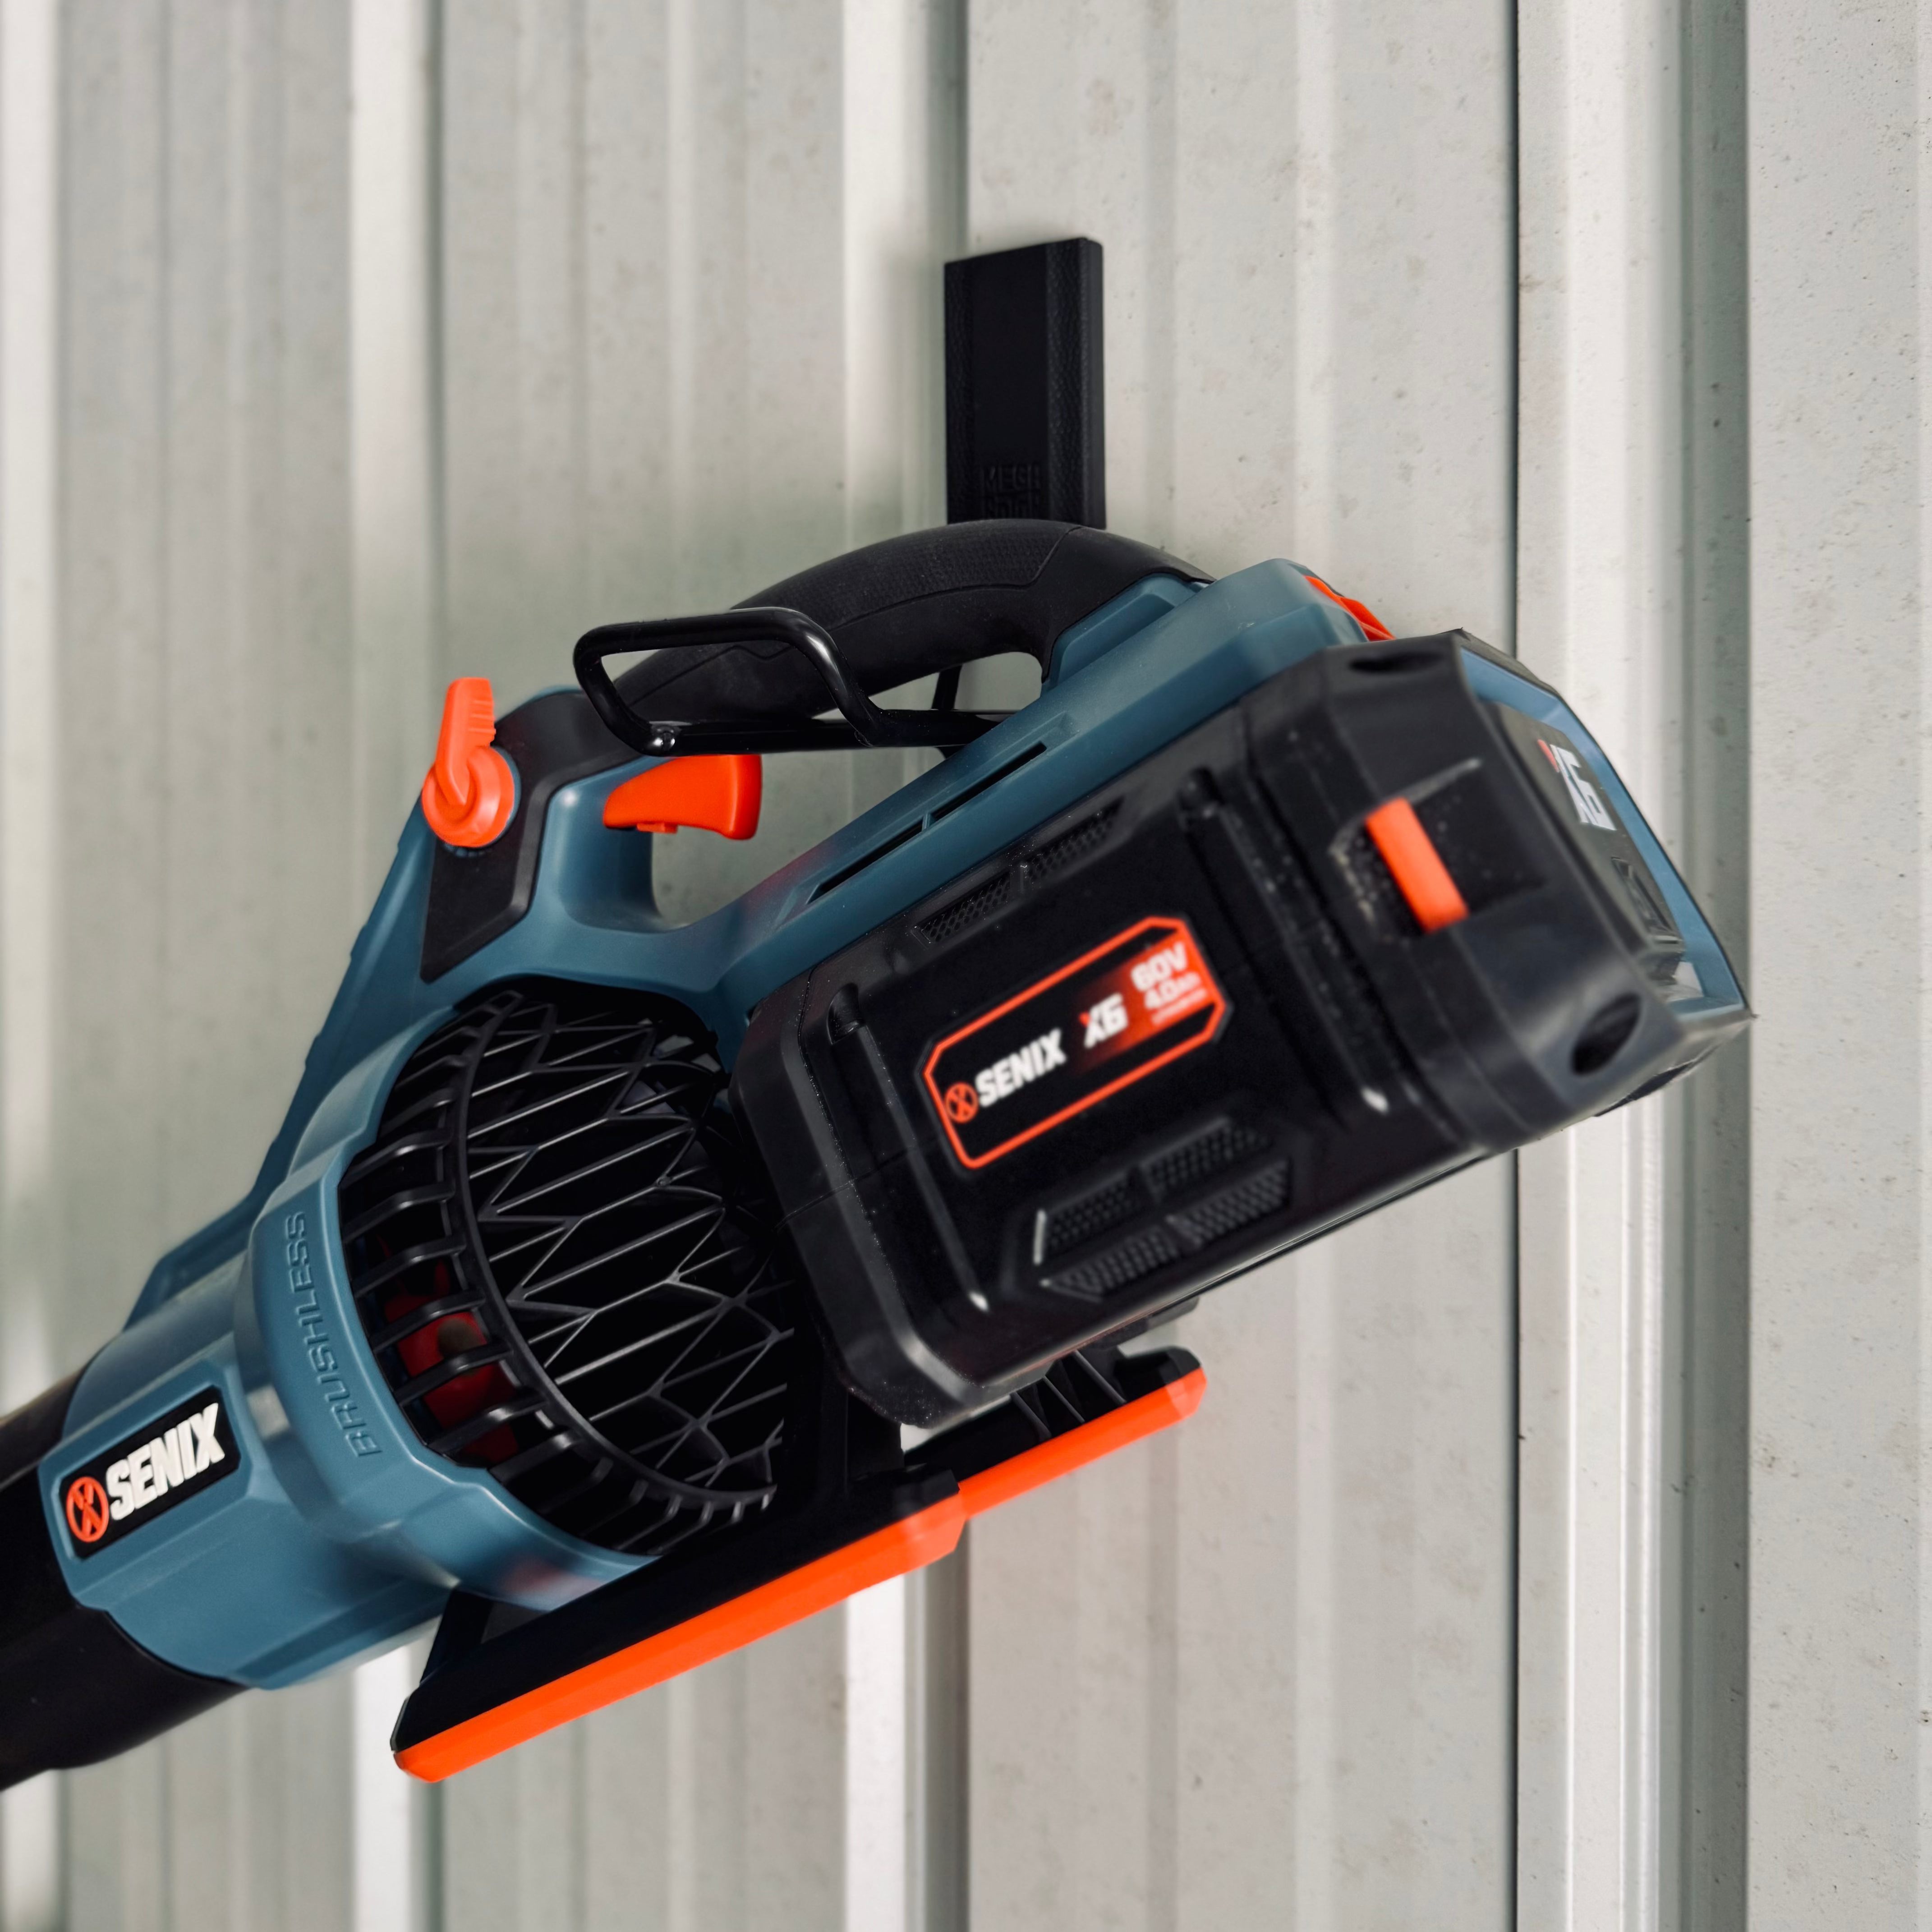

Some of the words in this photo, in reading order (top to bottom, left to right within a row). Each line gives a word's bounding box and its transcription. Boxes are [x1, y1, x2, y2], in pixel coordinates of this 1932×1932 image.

[975, 1028, 1067, 1108] SENIX
[1079, 993, 1128, 1049] X6
[285, 1210, 383, 1458] BRUSHLESS
[106, 1403, 225, 1521] SENIX
